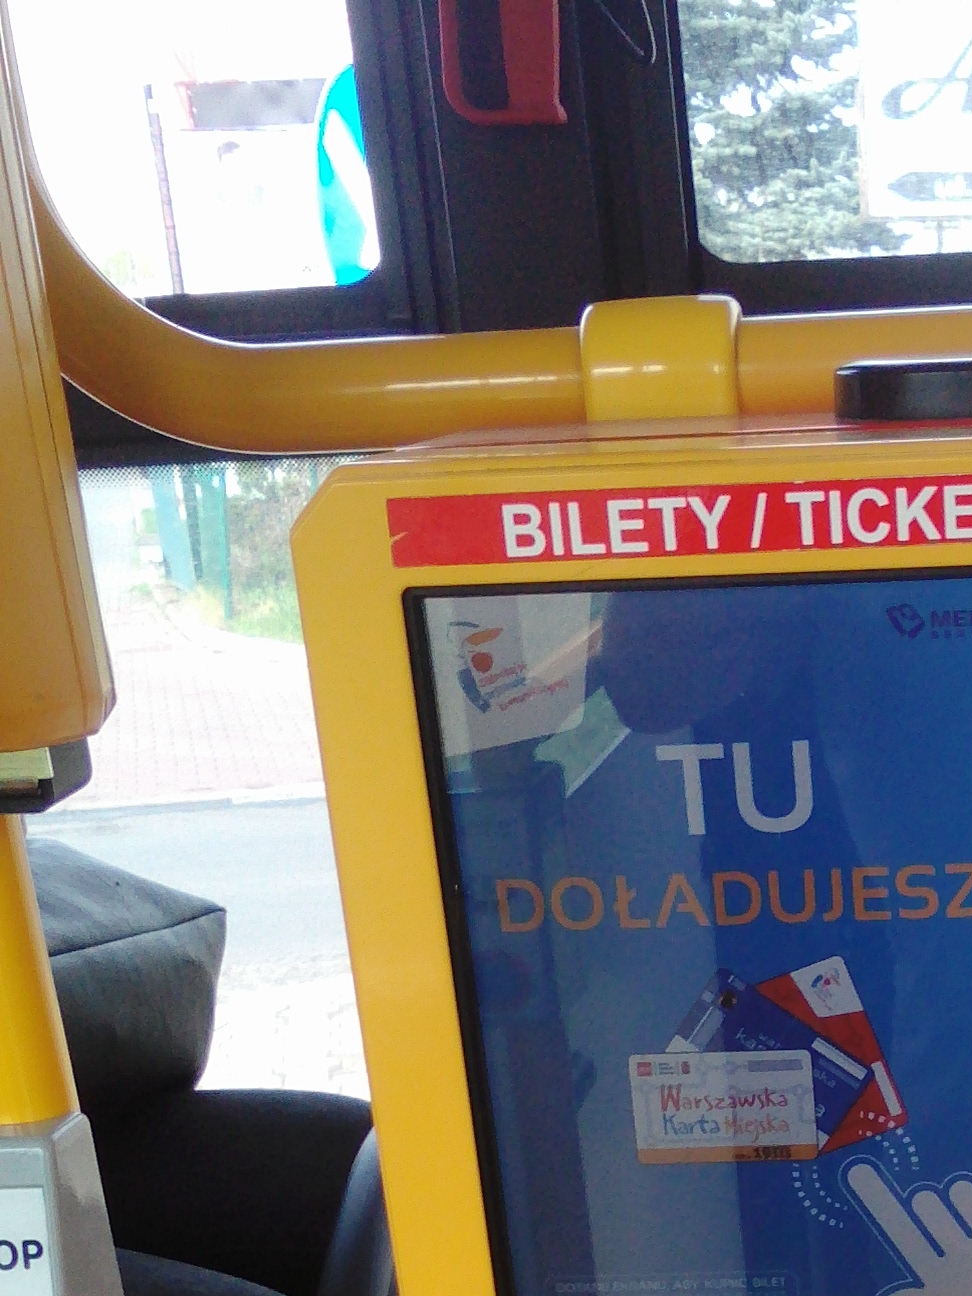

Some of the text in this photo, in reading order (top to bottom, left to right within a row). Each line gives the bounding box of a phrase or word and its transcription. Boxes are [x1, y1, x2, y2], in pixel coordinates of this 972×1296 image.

[501, 493, 730, 558] BILETY
[750, 492, 768, 549] /
[655, 739, 814, 836] TU
[660, 1083, 789, 1112] Warszawska
[663, 1112, 790, 1143] Karta Miejska
